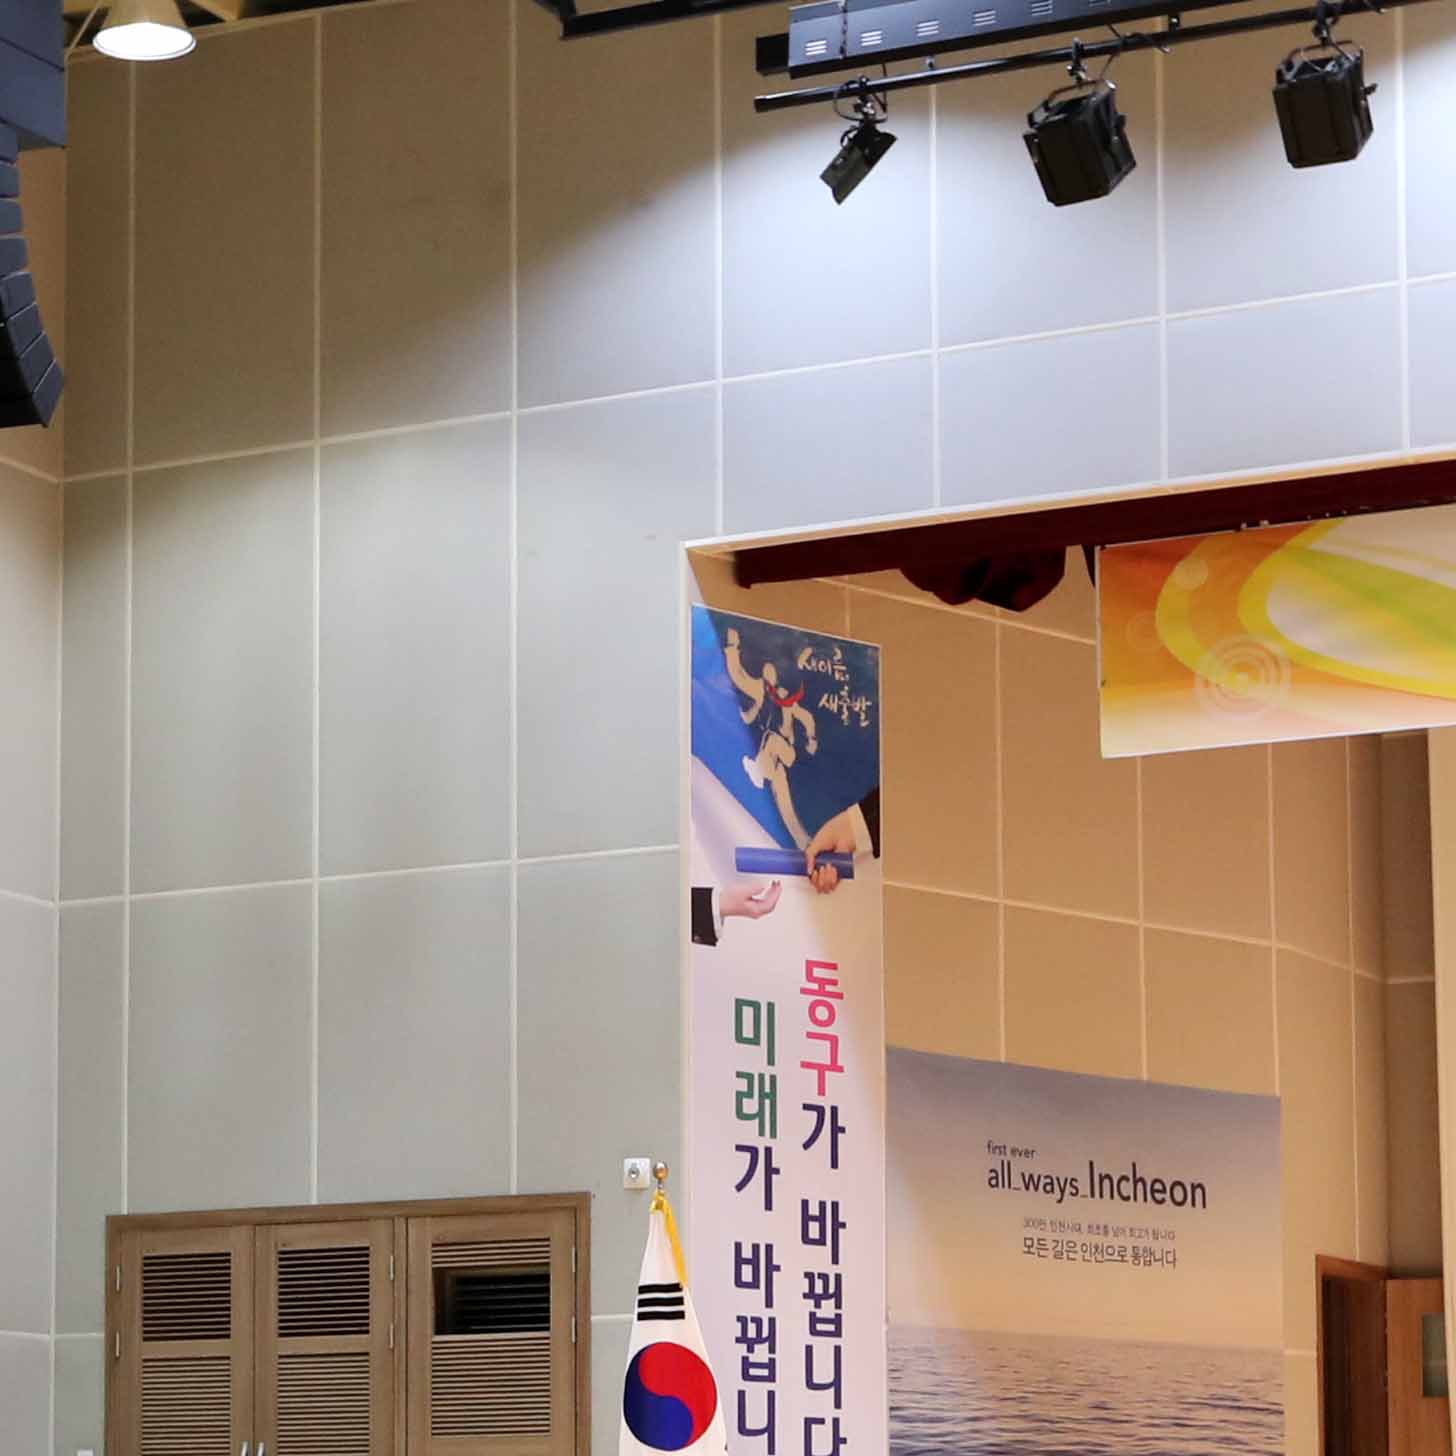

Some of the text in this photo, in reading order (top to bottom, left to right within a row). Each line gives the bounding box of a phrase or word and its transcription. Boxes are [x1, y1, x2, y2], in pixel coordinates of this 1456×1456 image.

[733, 996, 782, 1212] 미래가
[799, 958, 847, 1170] 동구가
[986, 1139, 1038, 1160] first ever
[1023, 1236, 1178, 1269] 모든 길은 인천으로 통합니다
